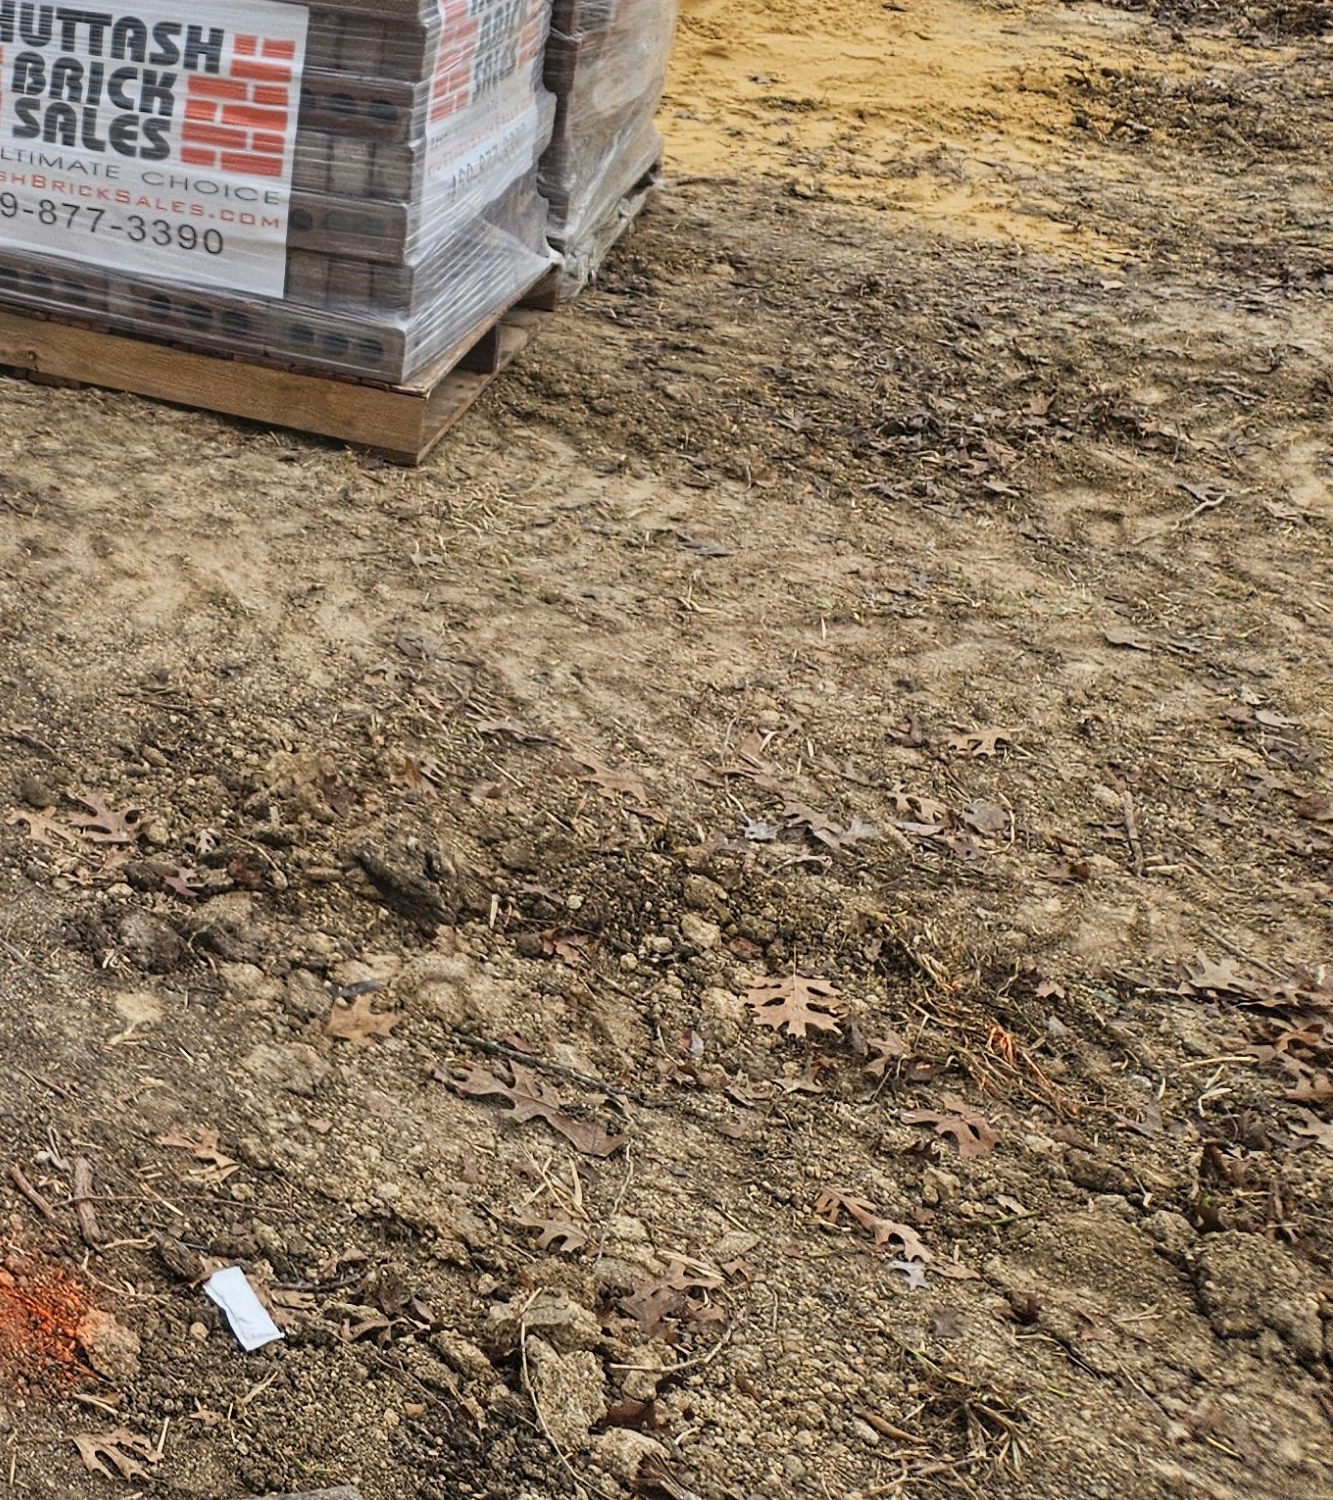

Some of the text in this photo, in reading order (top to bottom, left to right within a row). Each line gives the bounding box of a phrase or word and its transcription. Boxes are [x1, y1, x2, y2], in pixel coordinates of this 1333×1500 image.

[11, 51, 178, 116] BRICK
[11, 97, 173, 161] SALES
[141, 171, 281, 205] CHOICE
